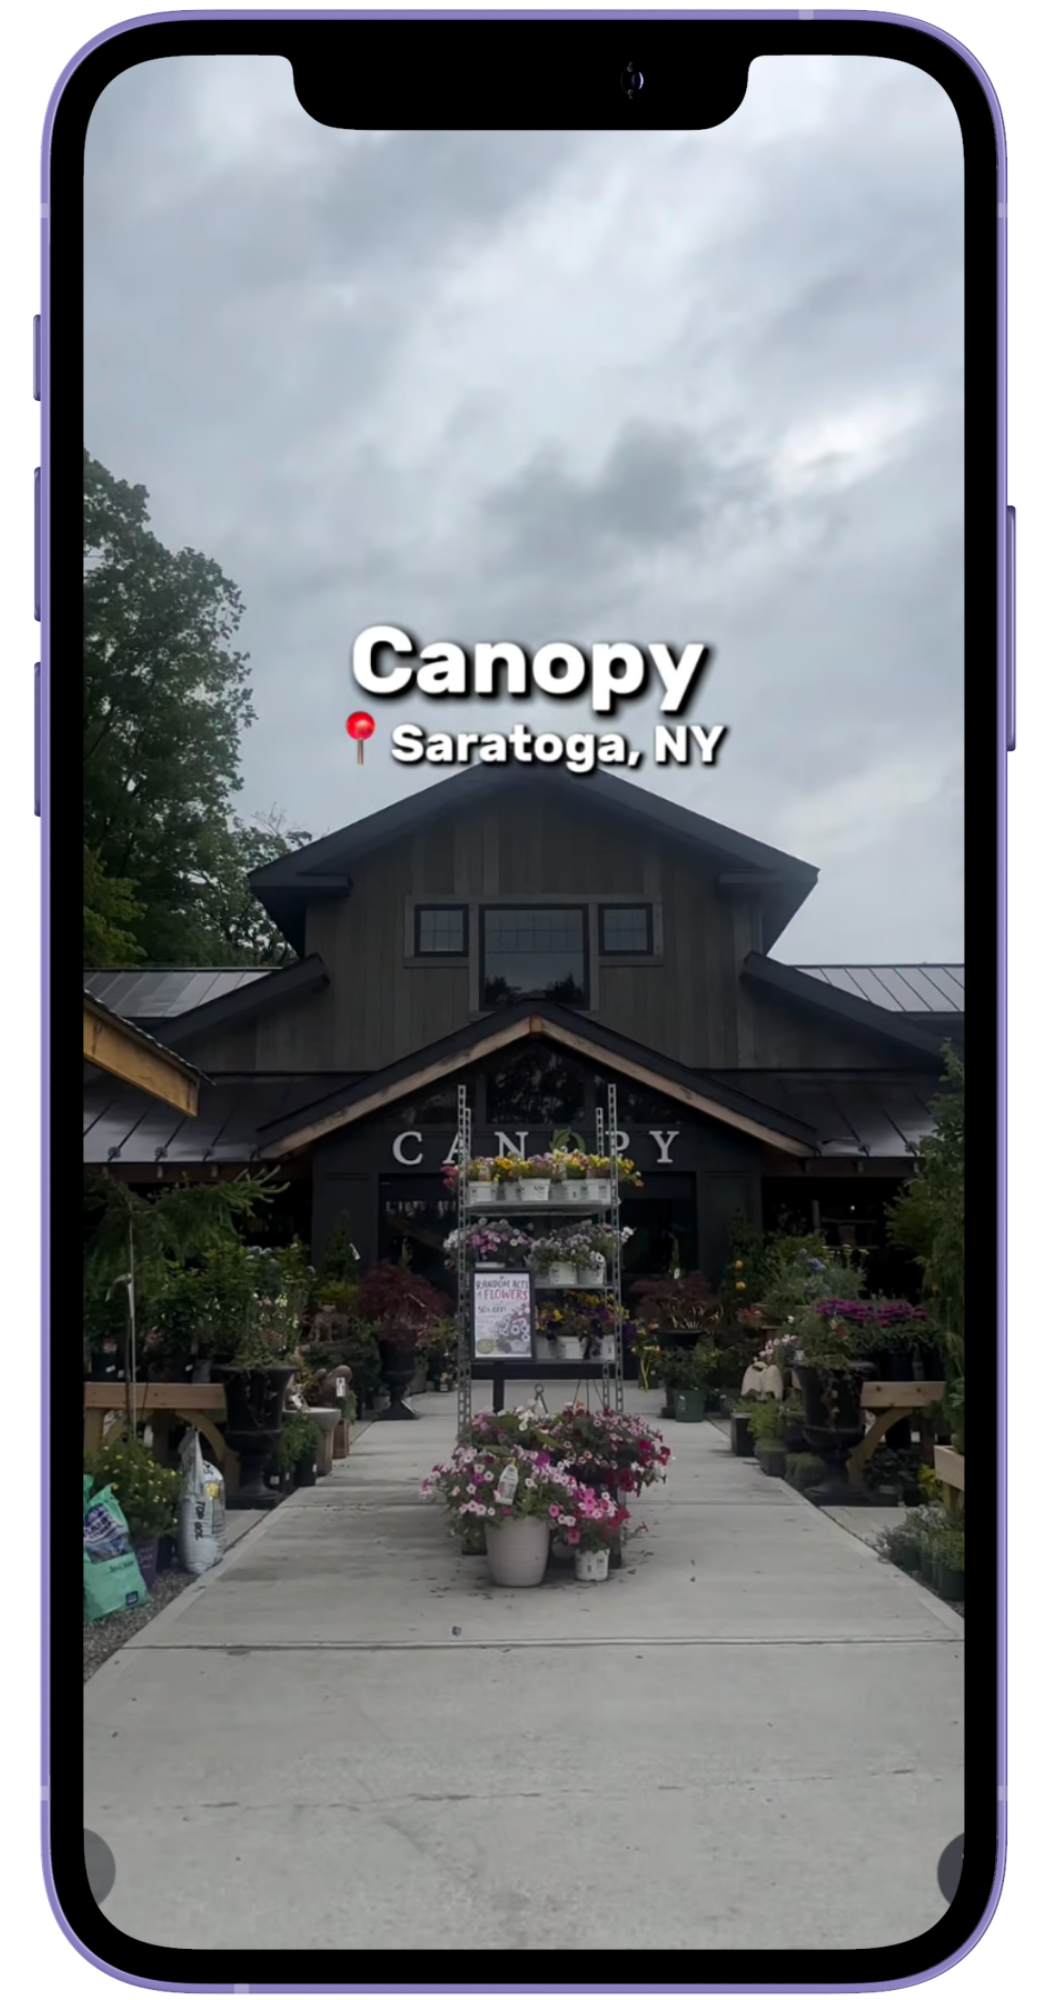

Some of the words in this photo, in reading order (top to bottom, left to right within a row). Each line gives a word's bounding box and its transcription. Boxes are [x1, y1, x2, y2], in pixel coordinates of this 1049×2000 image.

[476, 1279, 510, 1290] RANDOM
[512, 1279, 529, 1289] ACTS
[484, 1289, 528, 1300] FLOWERS
[195, 1501, 206, 1520] TOP
